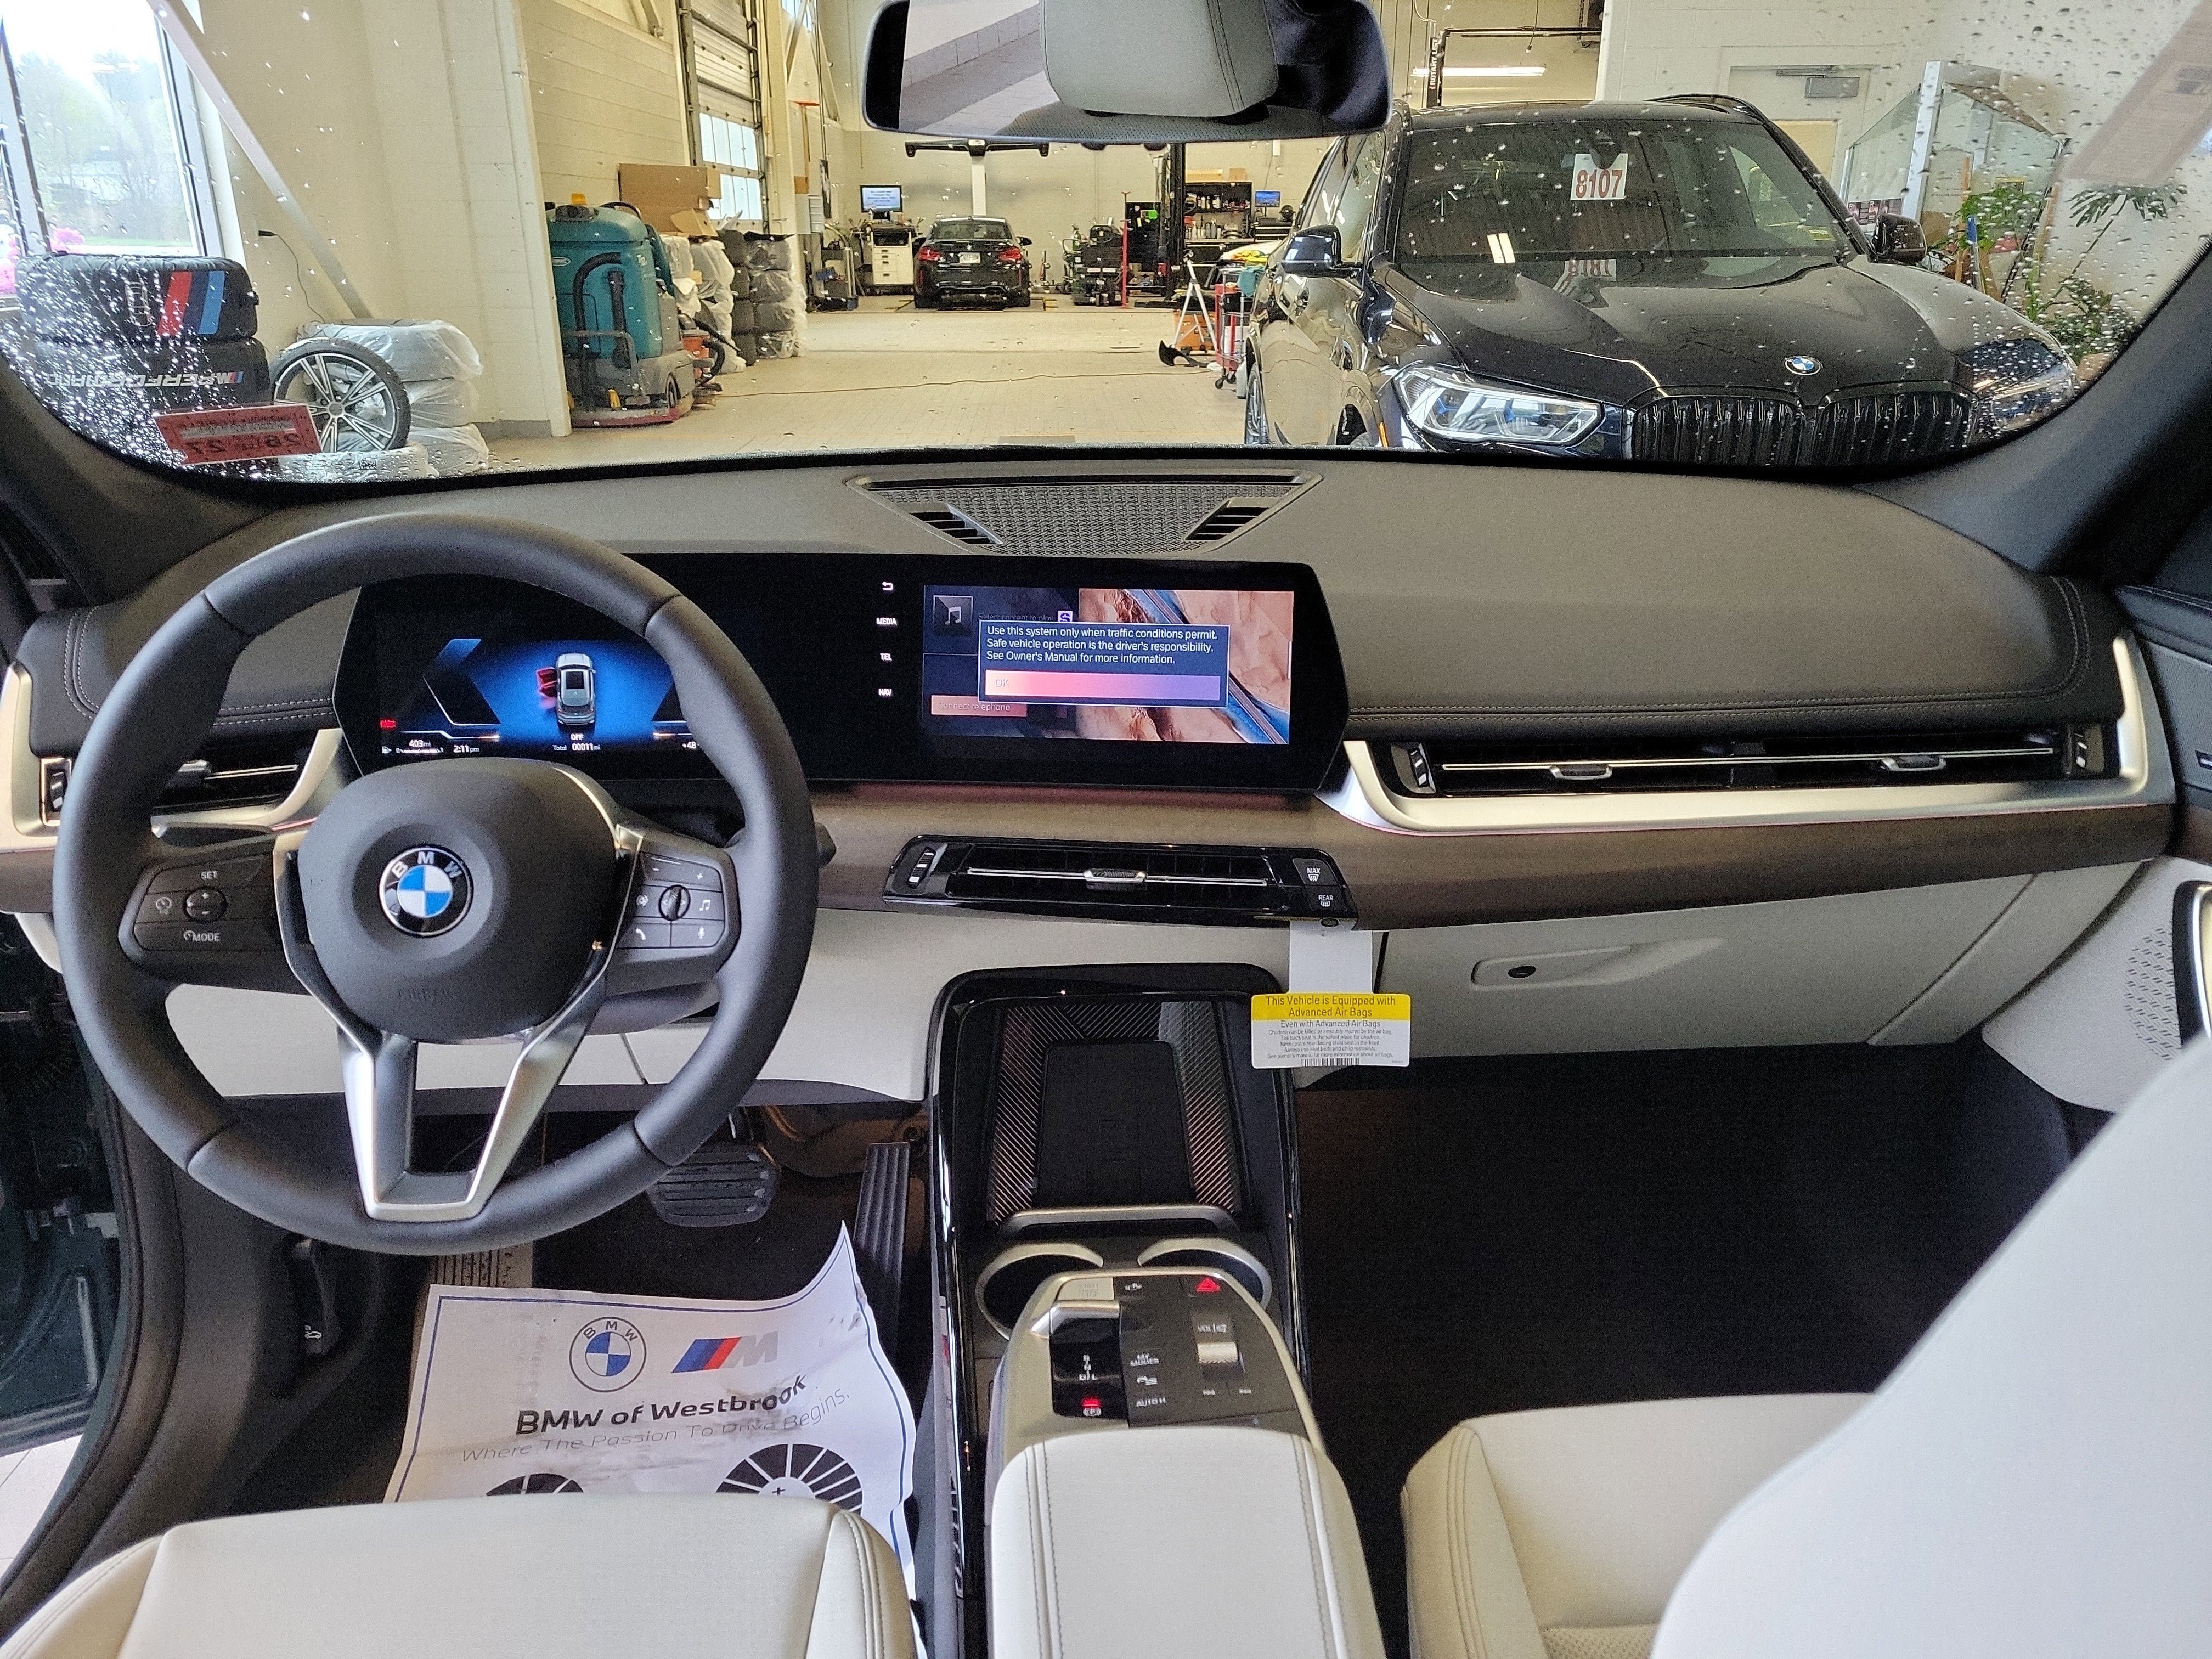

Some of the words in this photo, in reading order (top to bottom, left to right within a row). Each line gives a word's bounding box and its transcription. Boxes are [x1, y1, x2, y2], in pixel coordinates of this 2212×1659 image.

[1575, 168, 1623, 198] 8107
[988, 625, 1005, 635] Use
[1007, 626, 1024, 635] this
[1025, 627, 1058, 637] system
[1060, 627, 1079, 638] only
[1081, 628, 1105, 637] when
[1108, 628, 1133, 637] traffic
[1135, 629, 1183, 639] conditions
[1185, 630, 1217, 640] permit.
[986, 638, 1007, 647] Safe
[1009, 639, 1041, 648] vehicle
[1043, 640, 1086, 651] operation
[1089, 640, 1096, 650] is
[1098, 641, 1113, 650] the
[1115, 641, 1148, 651] driver's
[1151, 642, 1214, 653] responsibility.
[986, 651, 1004, 660] See
[1006, 651, 1043, 661] Owner's
[1045, 652, 1077, 662] Manual
[1080, 653, 1093, 662] for
[1095, 654, 1118, 663] more
[1121, 654, 1175, 664] information.
[995, 678, 1009, 687] OK
[938, 702, 970, 710] Connect
[972, 703, 1011, 714] telephone
[391, 851, 462, 878] BMW
[201, 870, 218, 880] SET
[193, 932, 220, 943] MODE
[1266, 996, 1284, 1006] This
[1286, 995, 1319, 1005] Vehicle
[1322, 996, 1329, 1005] is
[1332, 995, 1375, 1007] Equipped
[1376, 996, 1396, 1005] with
[1289, 1007, 1333, 1017] Advanced
[1335, 1007, 1347, 1017] Air
[1350, 1007, 1373, 1019] Bags
[1363, 1019, 1381, 1029] Bags
[583, 1320, 638, 1342] BMW
[1198, 1324, 1213, 1333] VOL
[721, 1330, 778, 1369] M
[516, 1409, 603, 1435] BMW
[611, 1404, 644, 1425] of
[651, 1374, 807, 1421] Westbrook
[1136, 1397, 1159, 1408] AUTO
[1159, 1396, 1166, 1404] H
[462, 1444, 532, 1462] Where
[542, 1438, 584, 1451] The
[591, 1430, 677, 1448] Passion
[686, 1425, 713, 1438] To
[722, 1420, 775, 1434] Drive
[783, 1388, 850, 1431] Begins.
